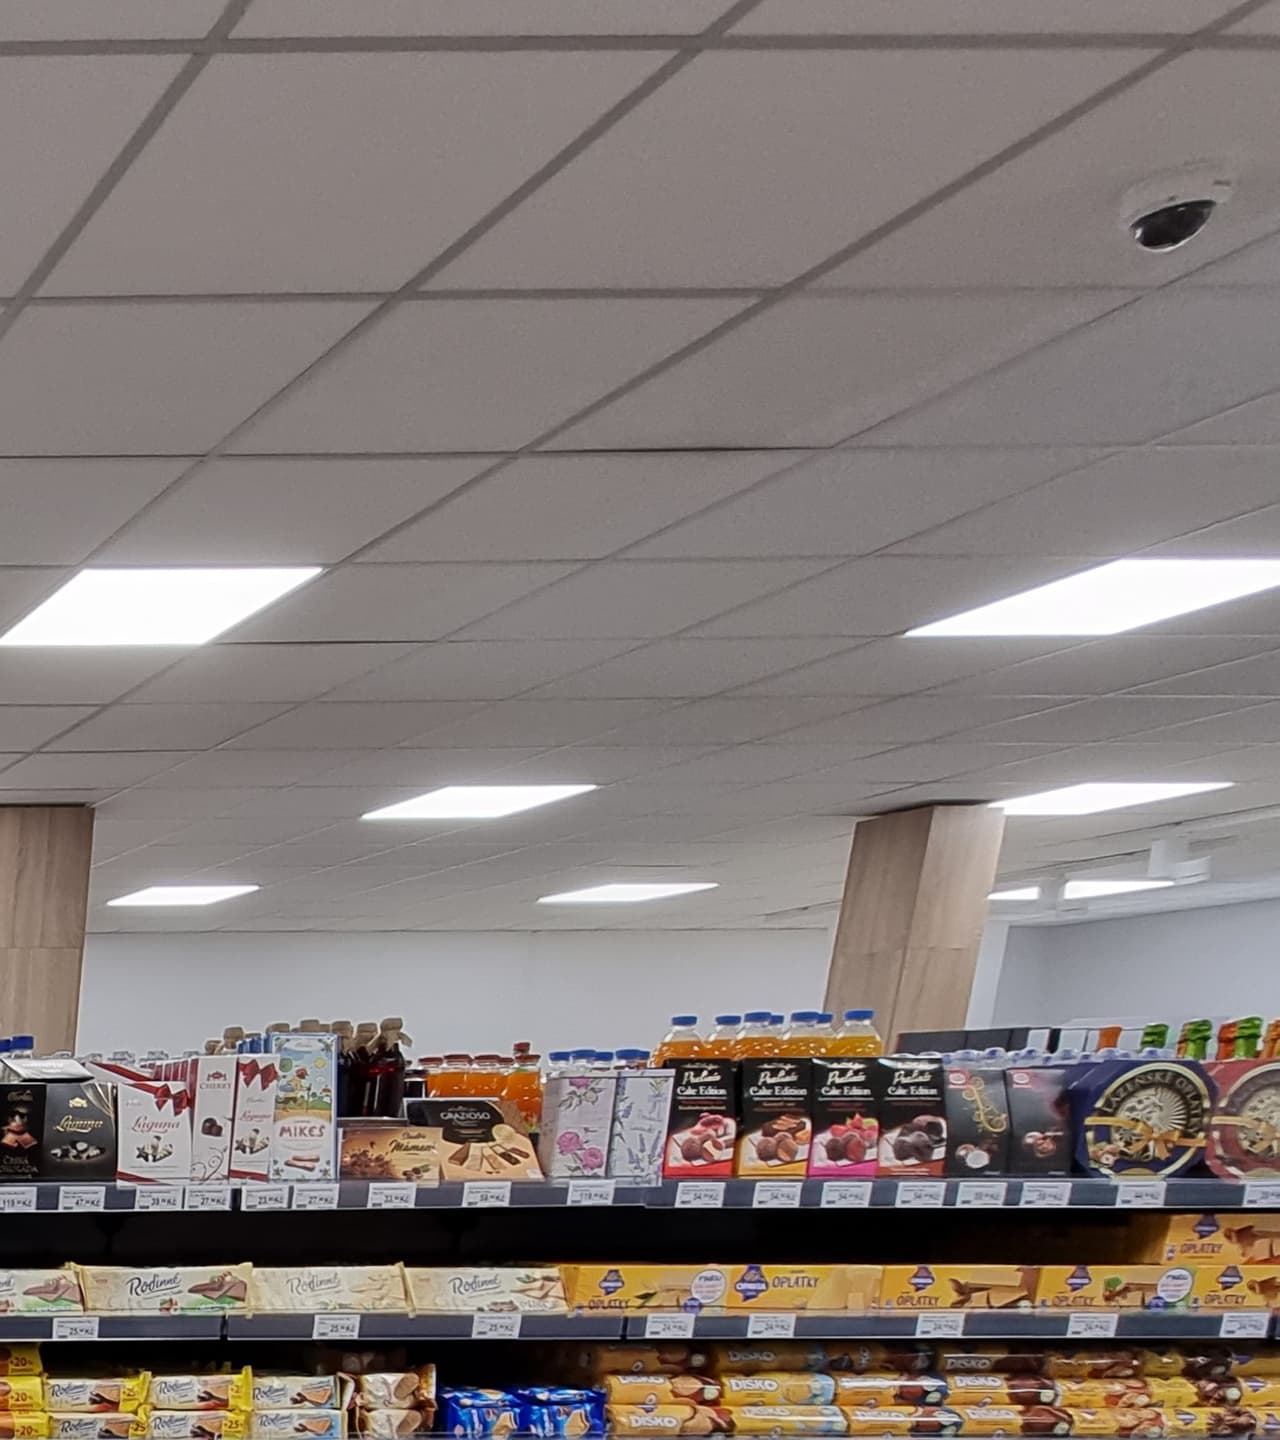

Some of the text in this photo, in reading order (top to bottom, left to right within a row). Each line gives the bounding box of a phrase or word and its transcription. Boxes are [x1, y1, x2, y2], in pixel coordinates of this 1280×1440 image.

[199, 1082, 232, 1091] CHERRY
[130, 1116, 181, 1134] Laguna
[126, 1273, 182, 1295] Rodinné
[287, 1275, 342, 1294] Rodinné
[448, 1274, 501, 1293] Rodinné
[729, 1378, 778, 1393] DISKO
[630, 1416, 680, 1428] DISKO
